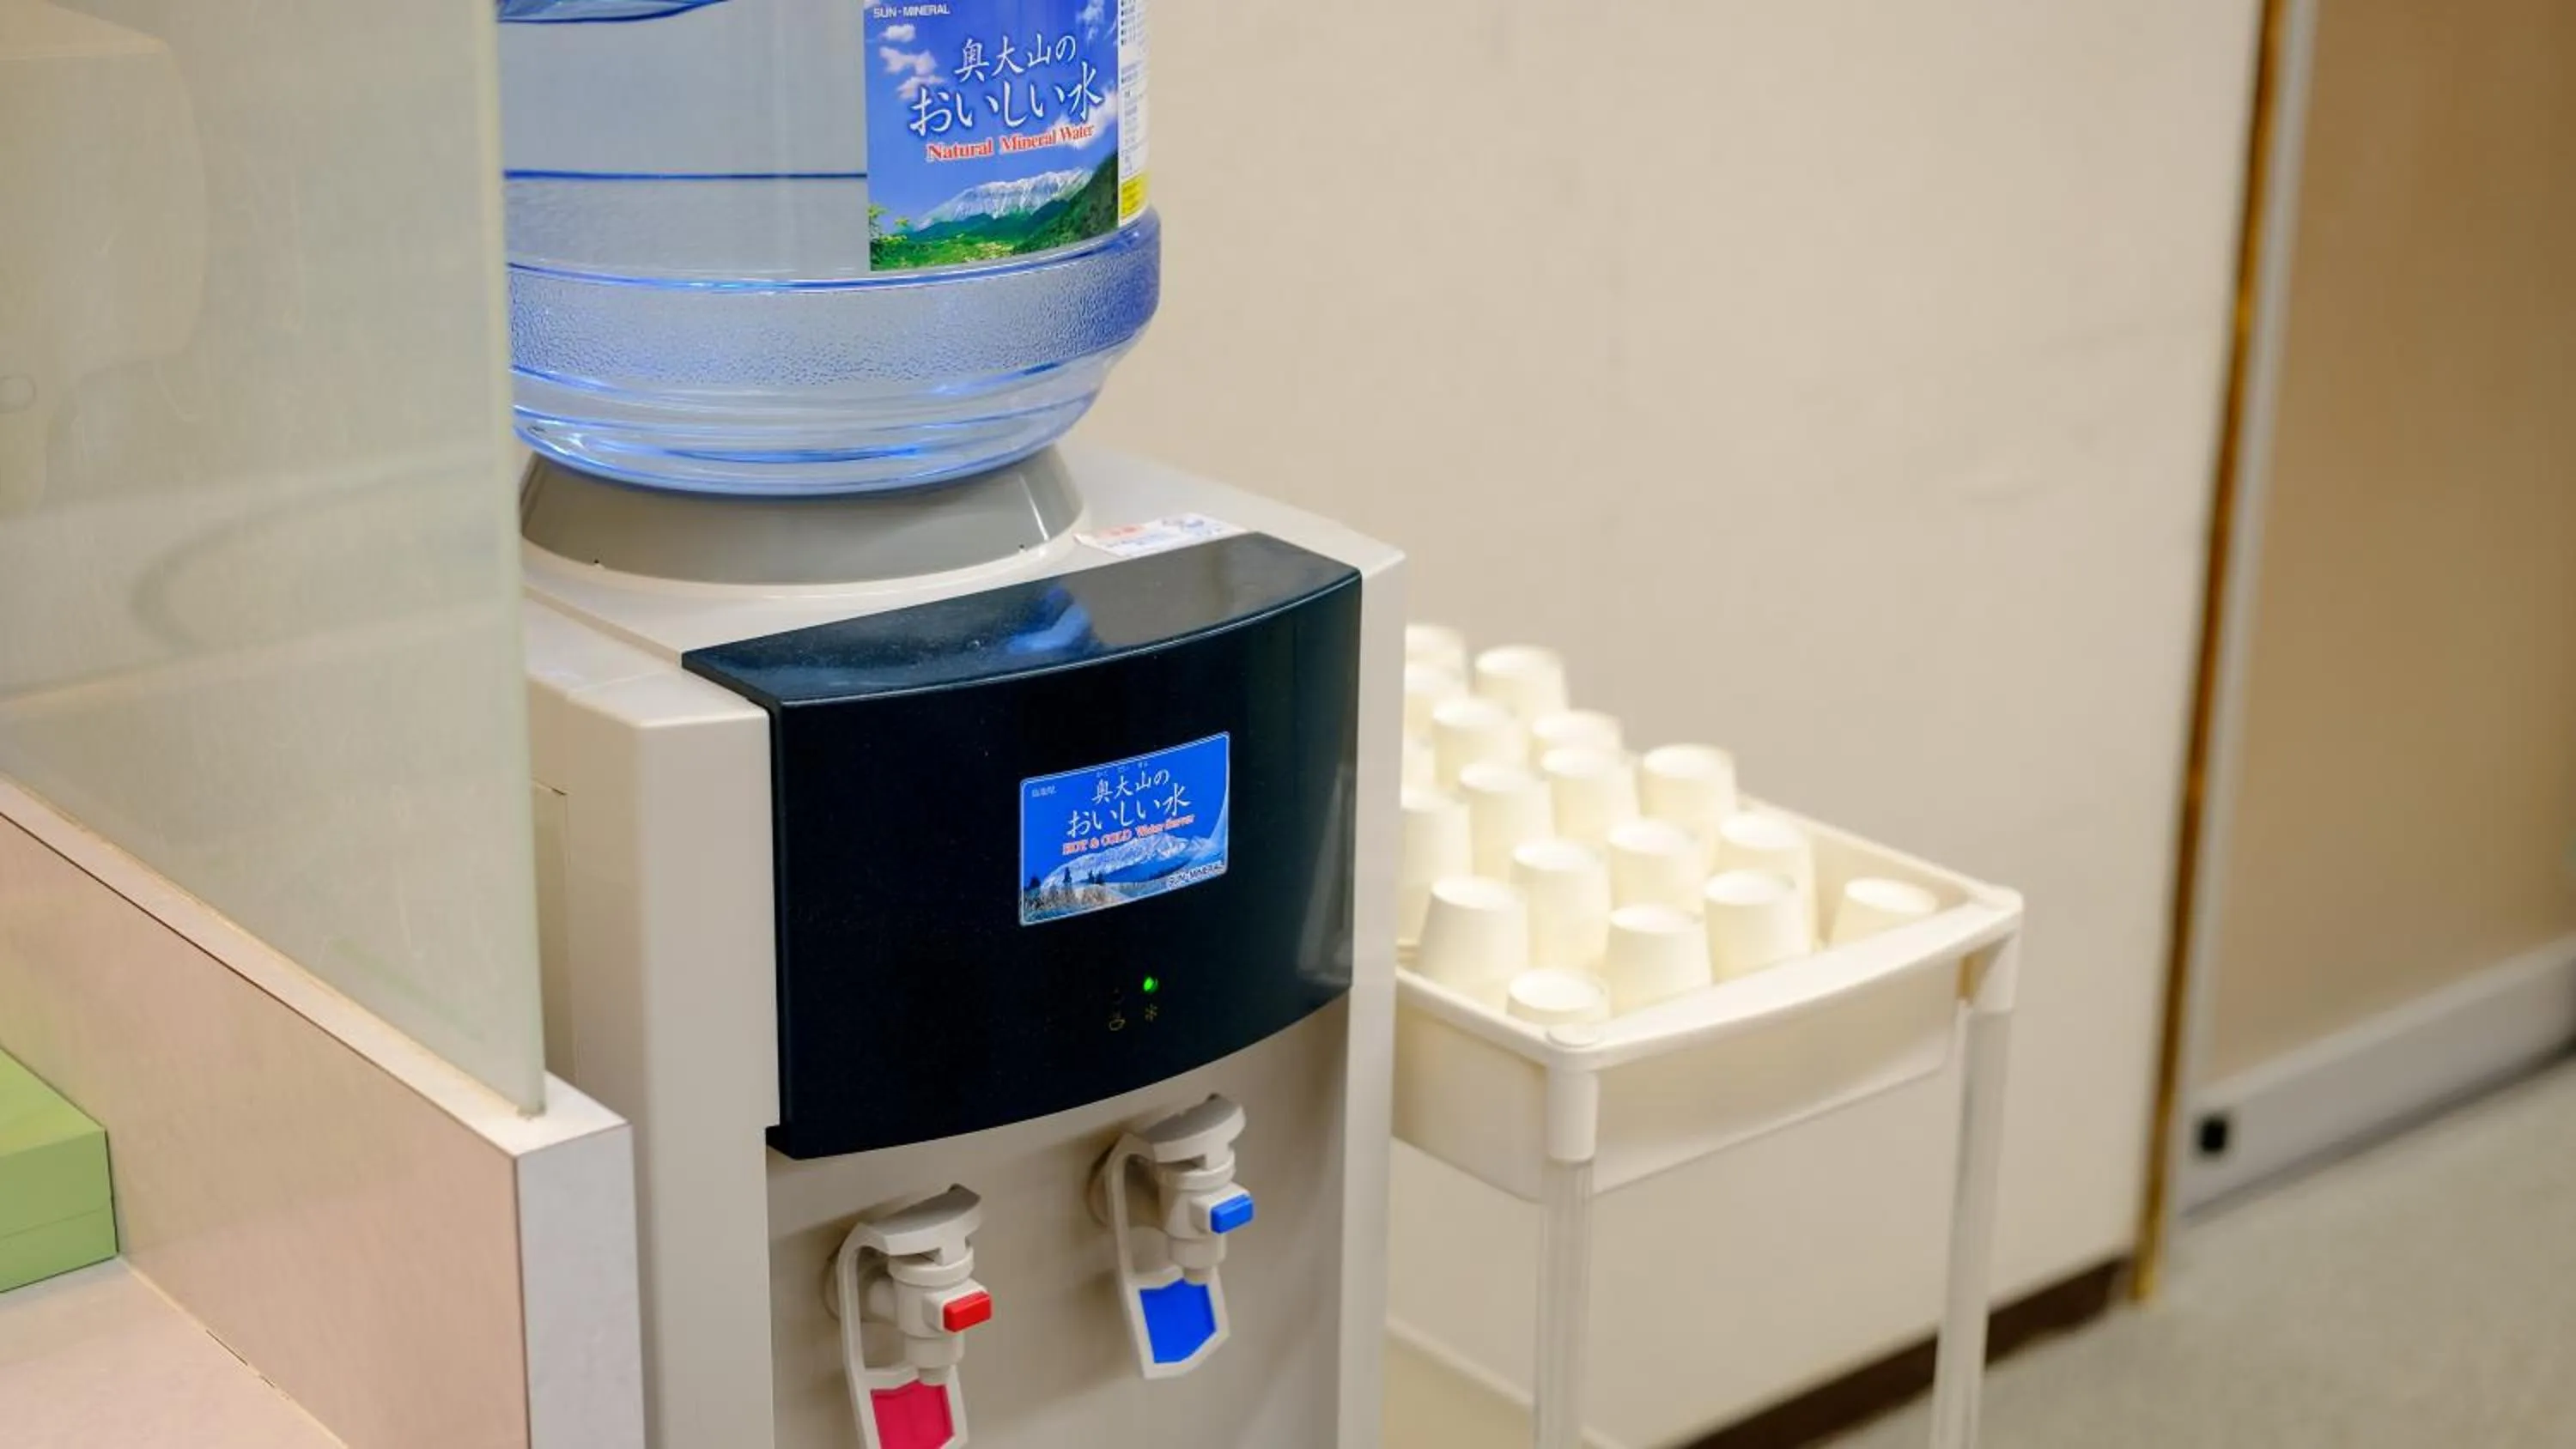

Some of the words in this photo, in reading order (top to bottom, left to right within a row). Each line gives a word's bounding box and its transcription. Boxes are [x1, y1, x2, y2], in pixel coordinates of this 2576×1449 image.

[954, 33, 1077, 83] 奥大山の
[908, 62, 1104, 136] おいしい水
[927, 138, 993, 161] Natural
[1001, 129, 1057, 153] Mineral
[1060, 124, 1095, 142] Water
[1067, 783, 1191, 838] おいしい水
[1092, 769, 1170, 803] 奥大山の
